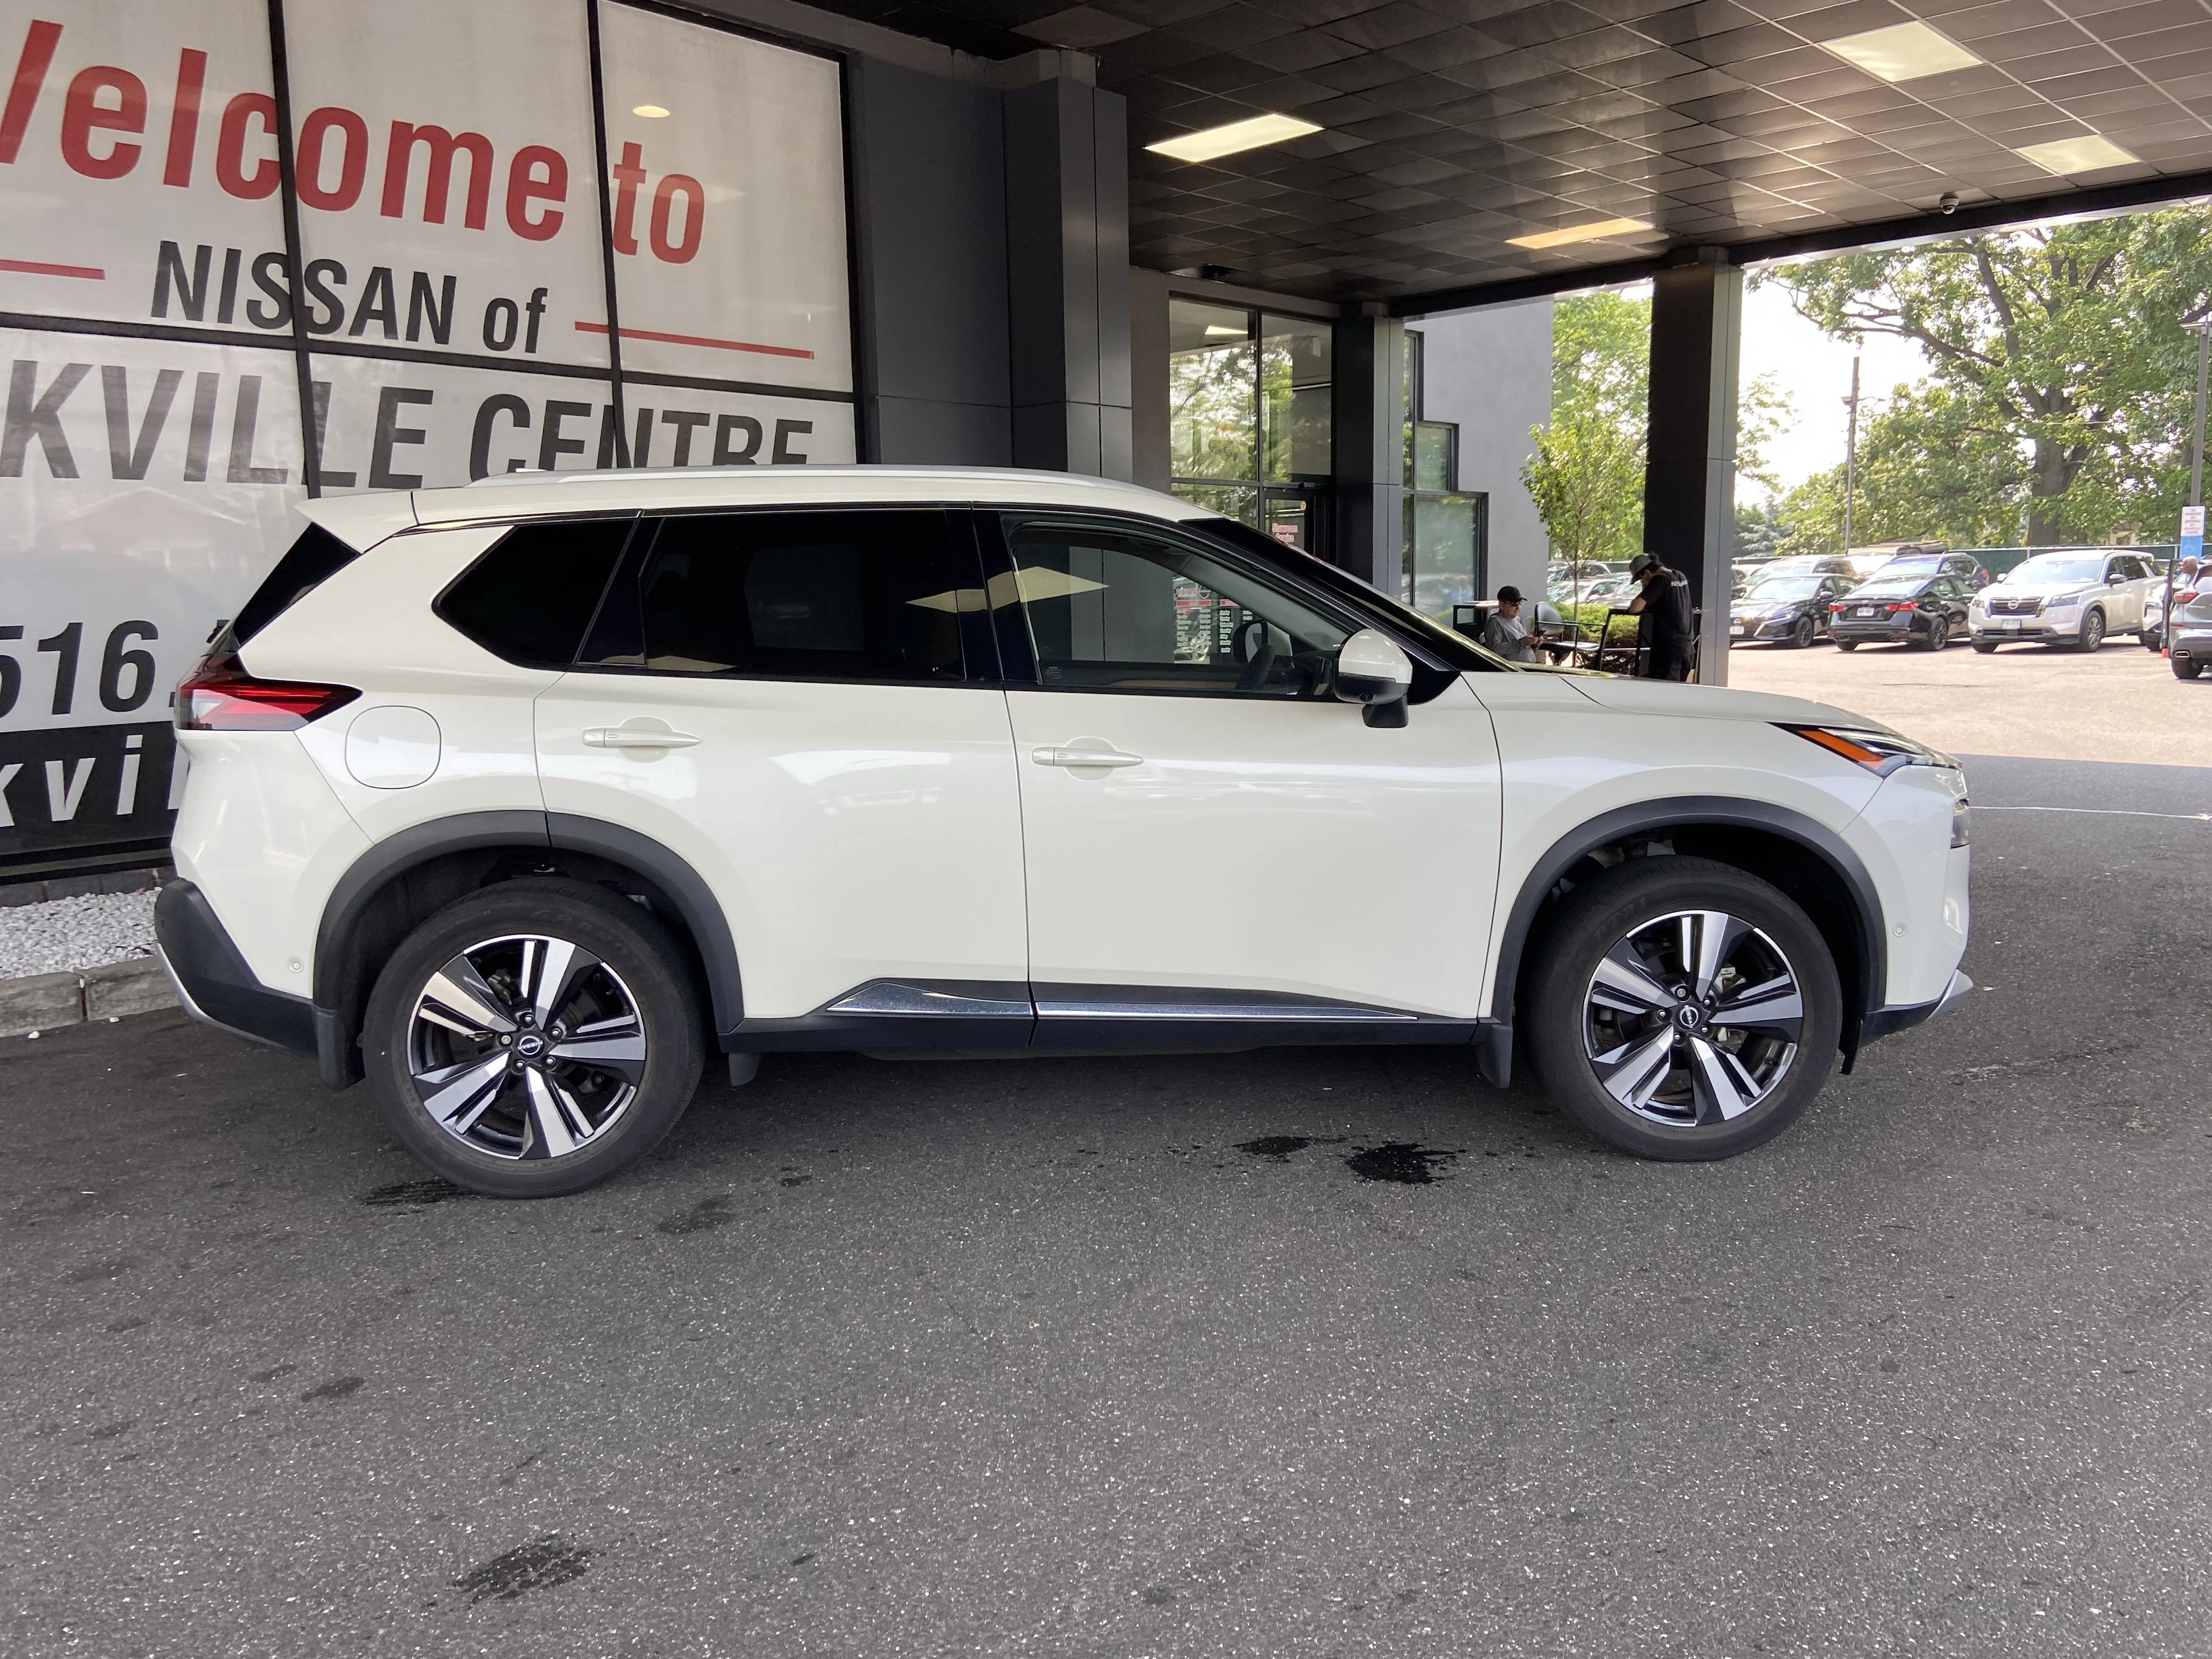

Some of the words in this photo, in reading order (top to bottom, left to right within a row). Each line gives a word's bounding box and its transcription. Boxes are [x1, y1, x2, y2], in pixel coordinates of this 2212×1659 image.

[612, 142, 705, 264] to
[151, 240, 457, 345] NISSAN
[483, 287, 548, 353] of
[469, 393, 814, 483] CENTRE
[1272, 523, 1299, 533] Showroom
[517, 1040, 544, 1051] NISSAN
